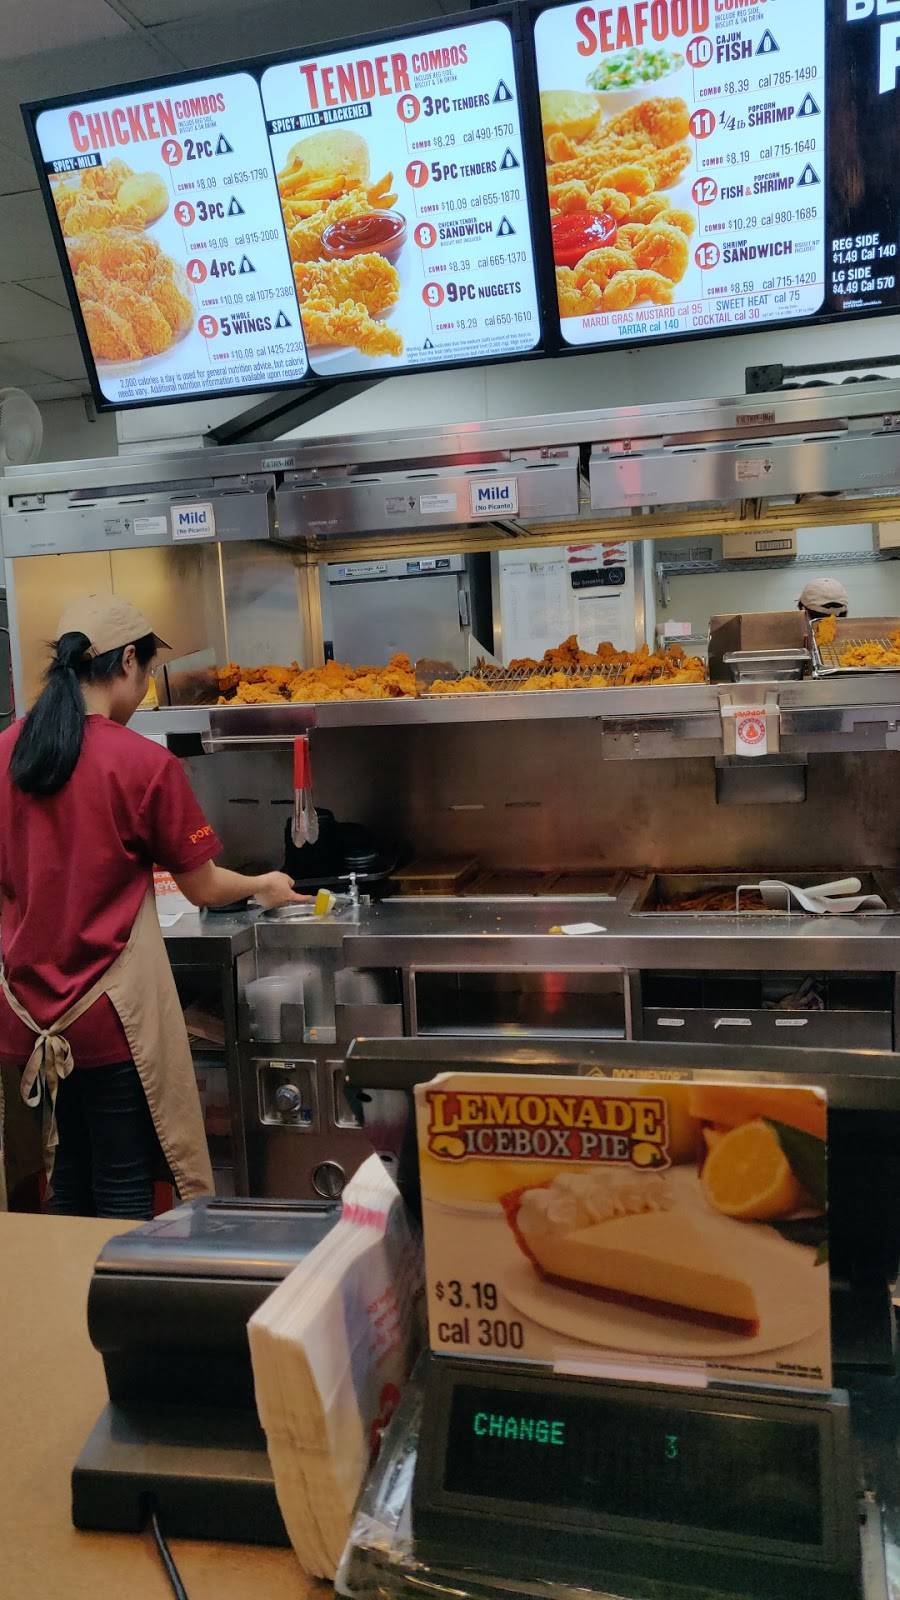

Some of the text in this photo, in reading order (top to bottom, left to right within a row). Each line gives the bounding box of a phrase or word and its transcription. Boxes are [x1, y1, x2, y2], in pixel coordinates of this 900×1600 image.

[576, 0, 710, 56] SEAFOOD
[716, 32, 741, 44] CAJUN
[717, 39, 752, 64] FISH
[300, 44, 468, 109] TENDER COMBOS
[724, 79, 749, 93] $8.39
[774, 66, 817, 85] 785-1490
[424, 96, 450, 116] 3PC
[453, 94, 490, 111] TENDERS
[748, 102, 776, 112] POPCORN
[67, 98, 177, 153] CHICKEN
[174, 93, 225, 119] COMBOS
[693, 113, 711, 135] 11
[748, 106, 794, 127] SHRIMP
[434, 134, 455, 147] $8.29
[476, 123, 513, 140] 490-1570
[184, 139, 213, 160] 2PC
[727, 150, 750, 164] $8.19
[774, 138, 816, 156] 715-1640
[411, 161, 497, 184] 7 5PC TENDERS
[754, 172, 780, 182] POPCORN
[694, 177, 794, 201] 12 FISH & SHRIMP
[197, 201, 225, 221] 3PC
[442, 198, 467, 211] $10.09
[728, 216, 757, 230] $10.29
[775, 207, 817, 223] 980-1685
[440, 221, 492, 240] SANDWICH
[723, 240, 747, 249] SHRIMP
[832, 234, 879, 251] REG SIDE
[696, 240, 792, 266] 13 SANDWICH
[833, 244, 896, 264] $1.49 Cal 140
[210, 259, 236, 278] 4PC
[449, 260, 470, 271] $8.39
[832, 266, 871, 282] LG SIDE
[447, 282, 475, 302] 9PC
[478, 282, 521, 299] NUGGETS
[731, 281, 754, 293] $8.59
[833, 276, 895, 294] $4.49 Cal 570
[716, 291, 800, 311] SWEET HEAT cal 75
[220, 317, 231, 336] 5
[232, 316, 272, 334] WINGS
[231, 312, 250, 320] WHOLE
[457, 318, 478, 329] $8.29
[582, 304, 702, 328] MARDI GRAS MUSTARD cal 95
[692, 313, 732, 326] COCKTAIL
[734, 311, 746, 322] cal
[748, 309, 760, 319] 30
[618, 319, 679, 336] TARTAR cal 140
[478, 486, 509, 500] Mild
[179, 511, 206, 524] Mild
[426, 1093, 663, 1142] LEMONADE
[464, 1128, 630, 1159] ICEBOX PIE
[436, 1280, 498, 1310] $3.19
[437, 1318, 524, 1349] cal 300
[474, 1412, 566, 1446] CHANGE
[665, 1435, 678, 1459] 3
